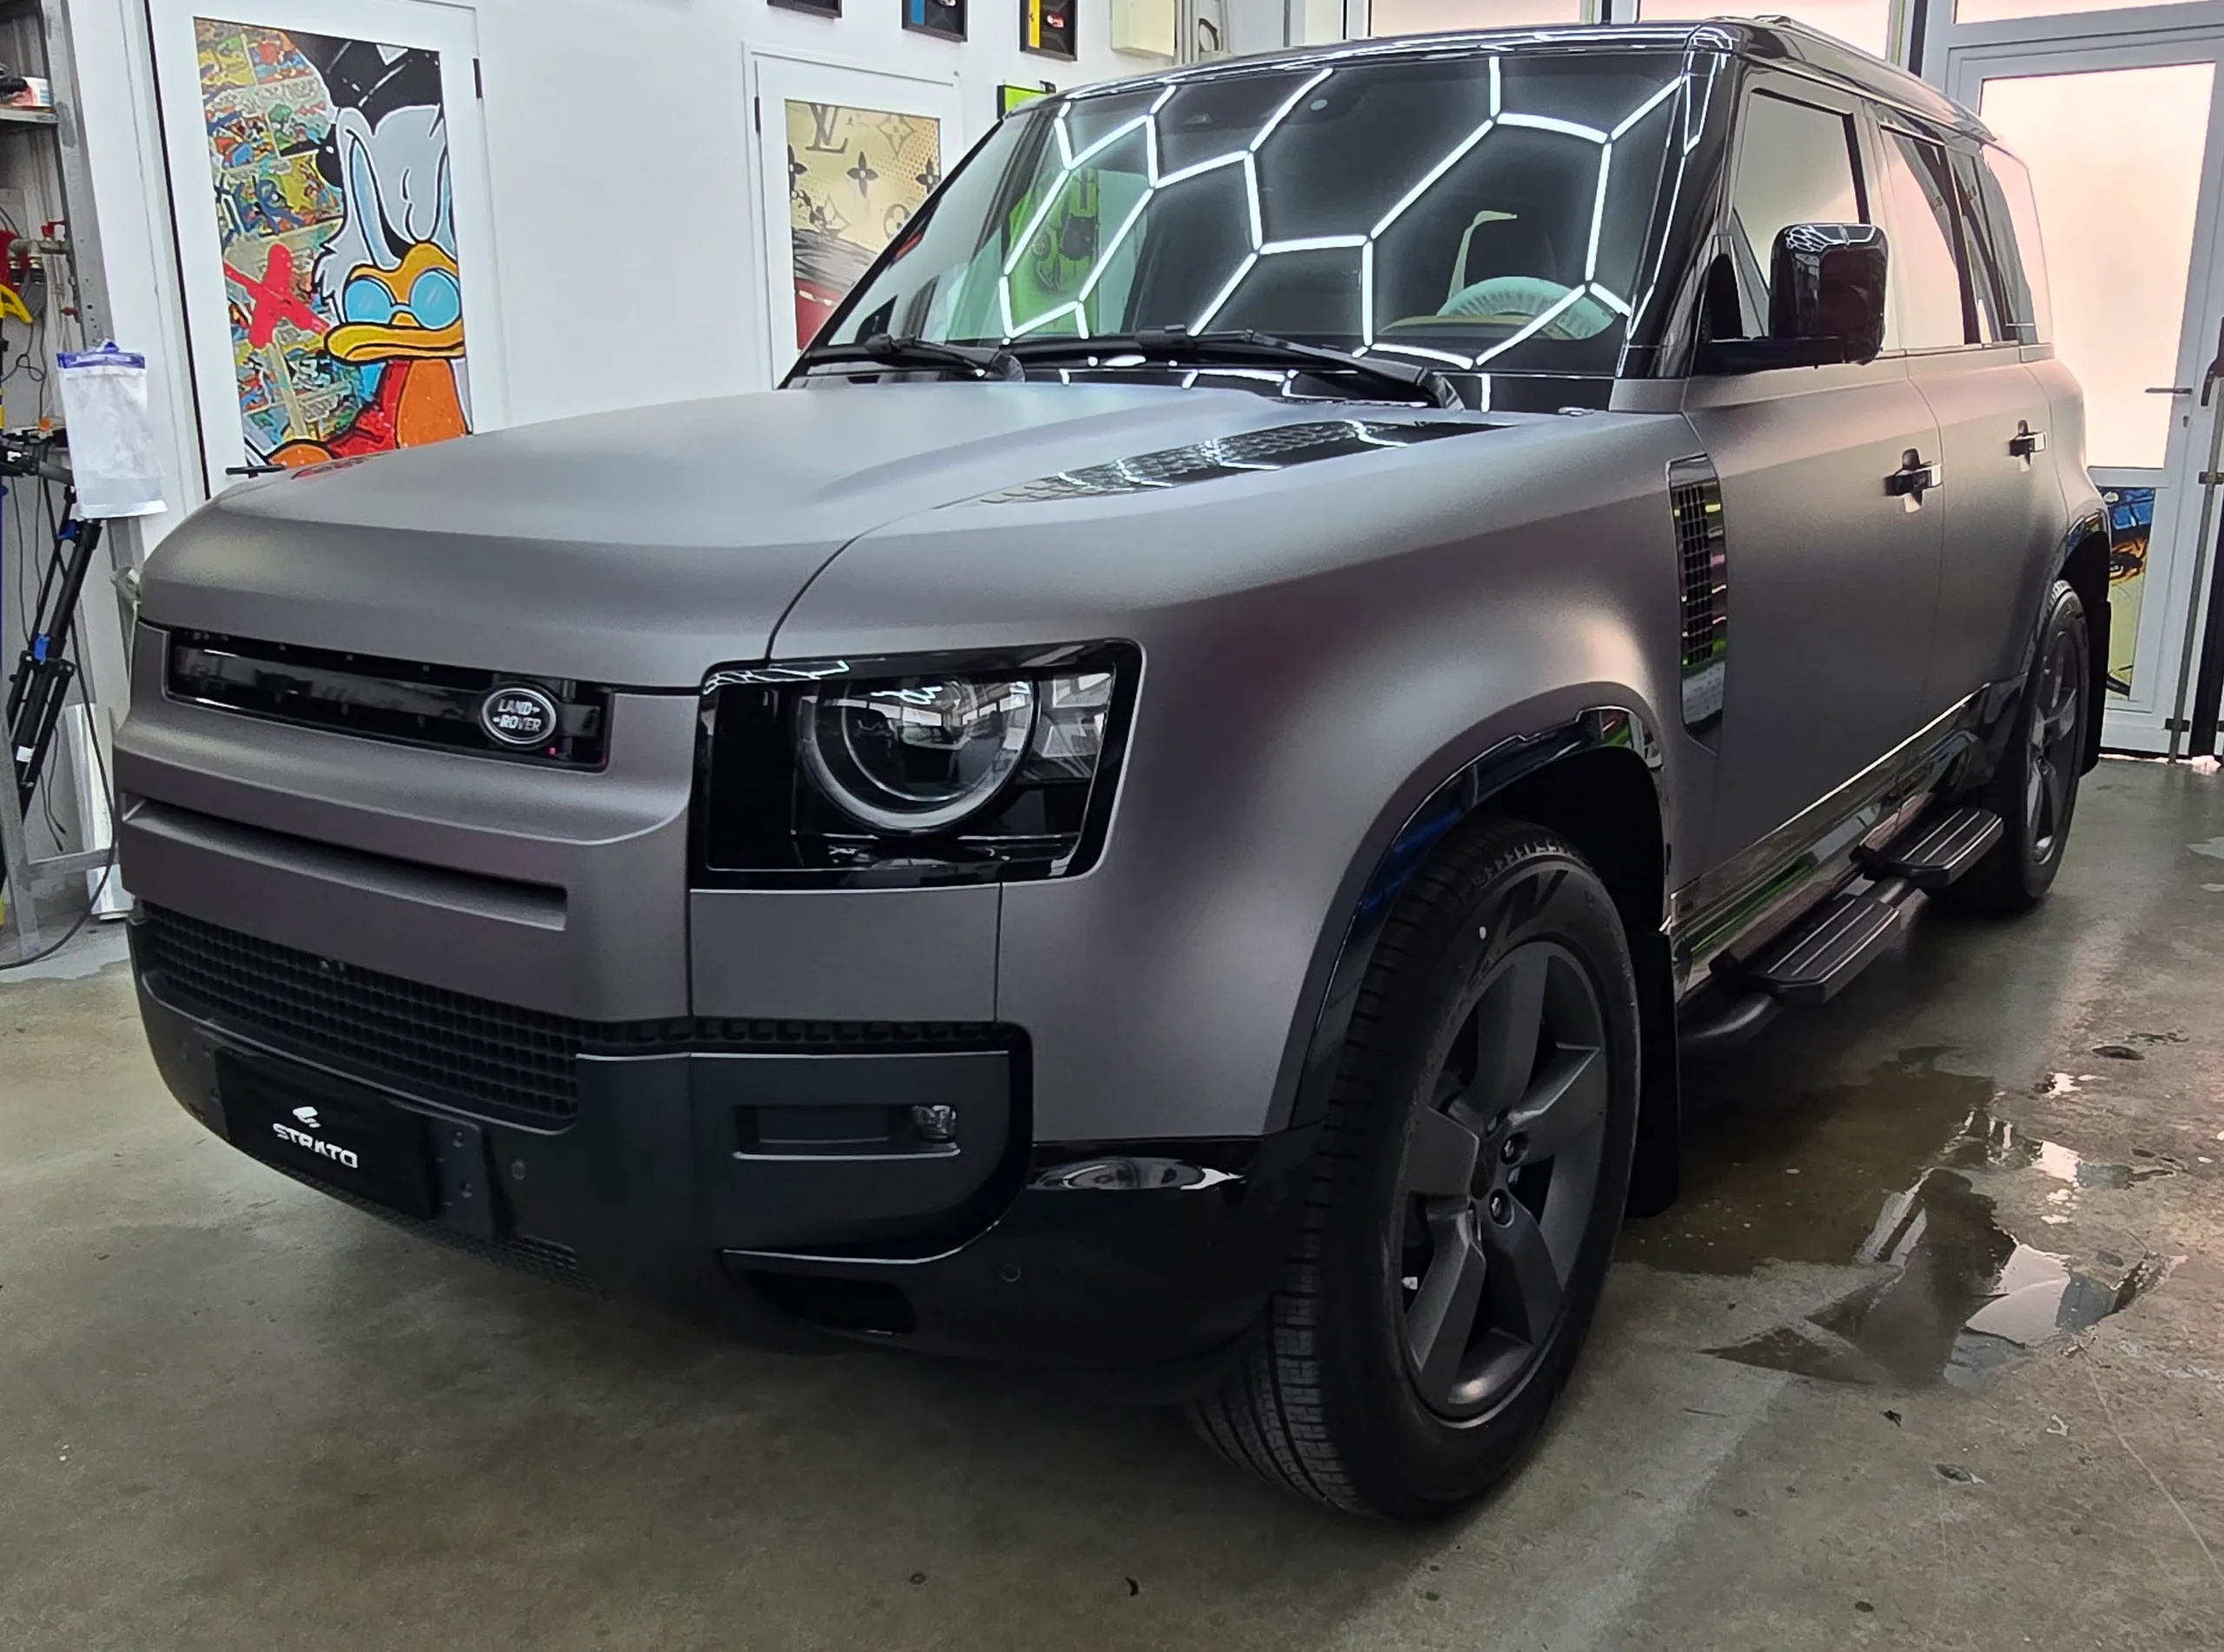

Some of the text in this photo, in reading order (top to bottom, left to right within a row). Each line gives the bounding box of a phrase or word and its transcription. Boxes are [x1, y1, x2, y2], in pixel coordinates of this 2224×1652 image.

[498, 699, 533, 714] LAND
[500, 715, 541, 731] ROVER
[273, 1123, 358, 1168] STRATO
